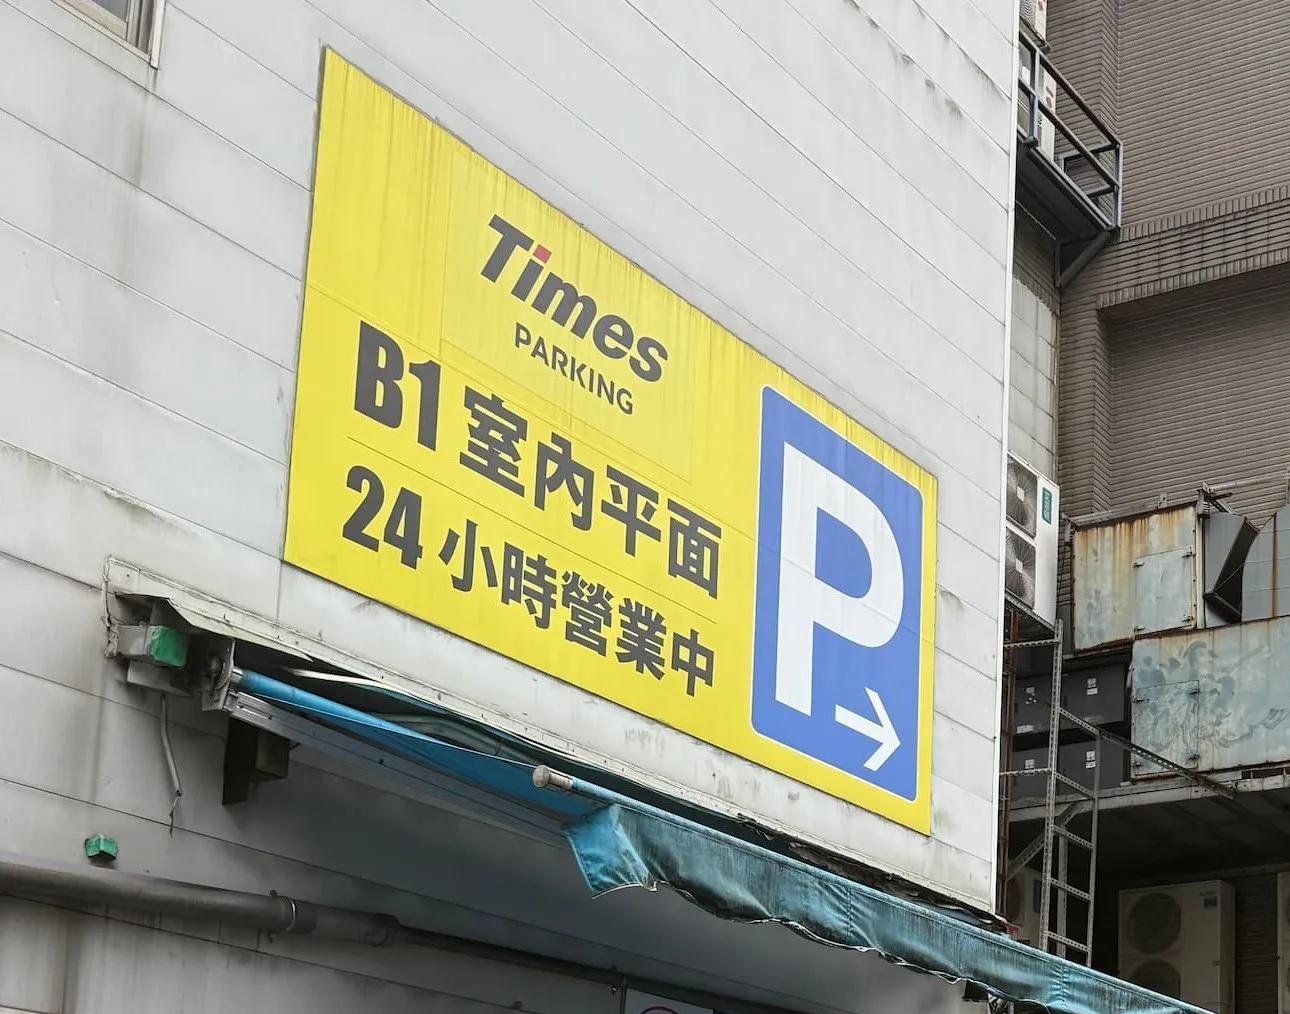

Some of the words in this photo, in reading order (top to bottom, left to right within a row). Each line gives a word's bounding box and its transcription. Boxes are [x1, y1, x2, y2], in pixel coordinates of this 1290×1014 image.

[479, 213, 669, 384] Times
[513, 321, 635, 415] PARKING
[354, 320, 441, 451] B1
[459, 384, 722, 600] 室內平面
[342, 465, 423, 570] 24
[439, 520, 715, 697] 小時營業中
[775, 440, 905, 716] P
